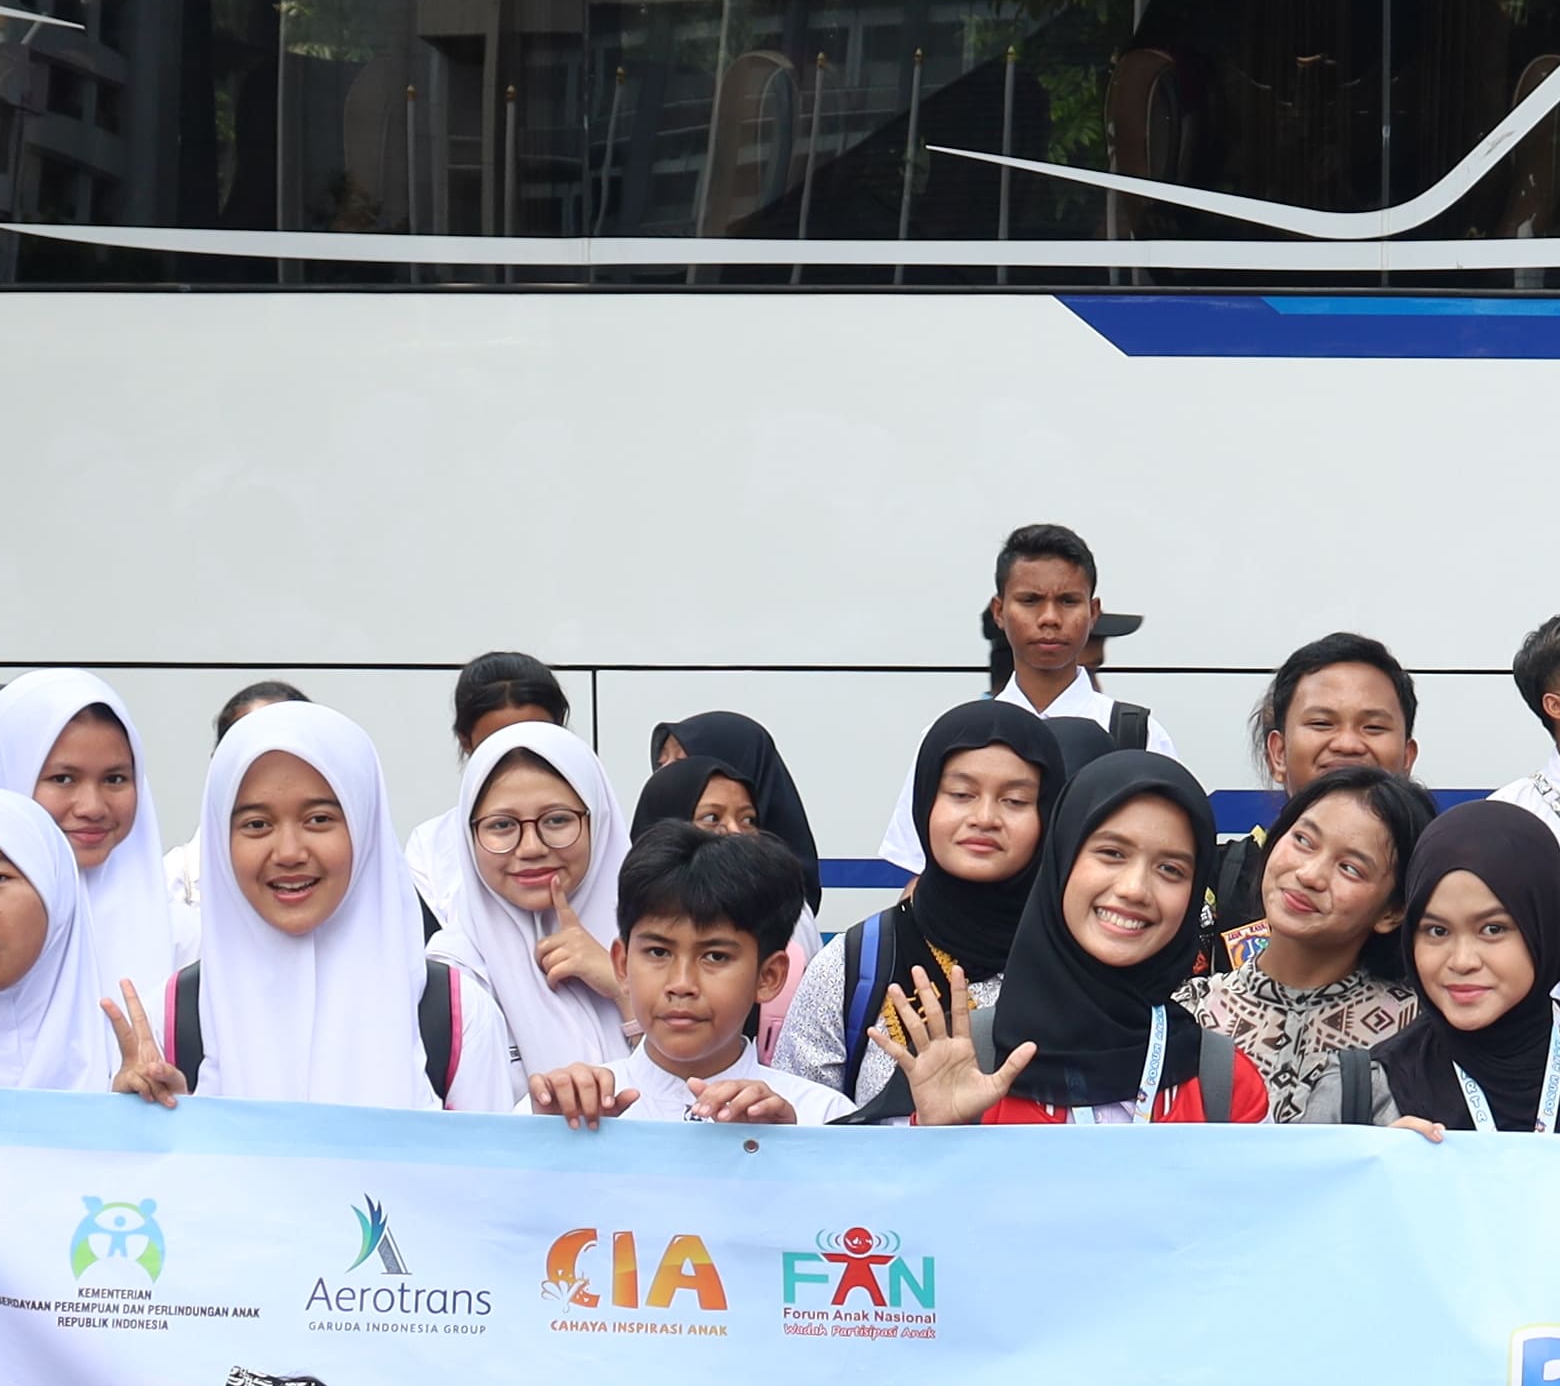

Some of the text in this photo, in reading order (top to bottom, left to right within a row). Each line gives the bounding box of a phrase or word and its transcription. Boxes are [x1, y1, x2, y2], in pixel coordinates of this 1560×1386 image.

[545, 1227, 729, 1313] CIA
[77, 1287, 153, 1301] KEMENTERIAN
[305, 1276, 492, 1316] Aerotrans
[53, 1302, 120, 1315] PEREMPUAN
[122, 1303, 144, 1316] DAN
[147, 1305, 229, 1318] PERLINDUNGAN
[231, 1307, 261, 1319] ANAK
[783, 1307, 937, 1325] Forum Anak Nasional
[57, 1316, 169, 1331] REPUBLIK INDONESIA
[308, 1320, 487, 1334] GARUDA INDONESIA GROUP
[549, 1318, 729, 1338] CAHAYA INSPIRASI ANAK
[783, 1322, 937, 1342] Wadah Partisipasi Anak
